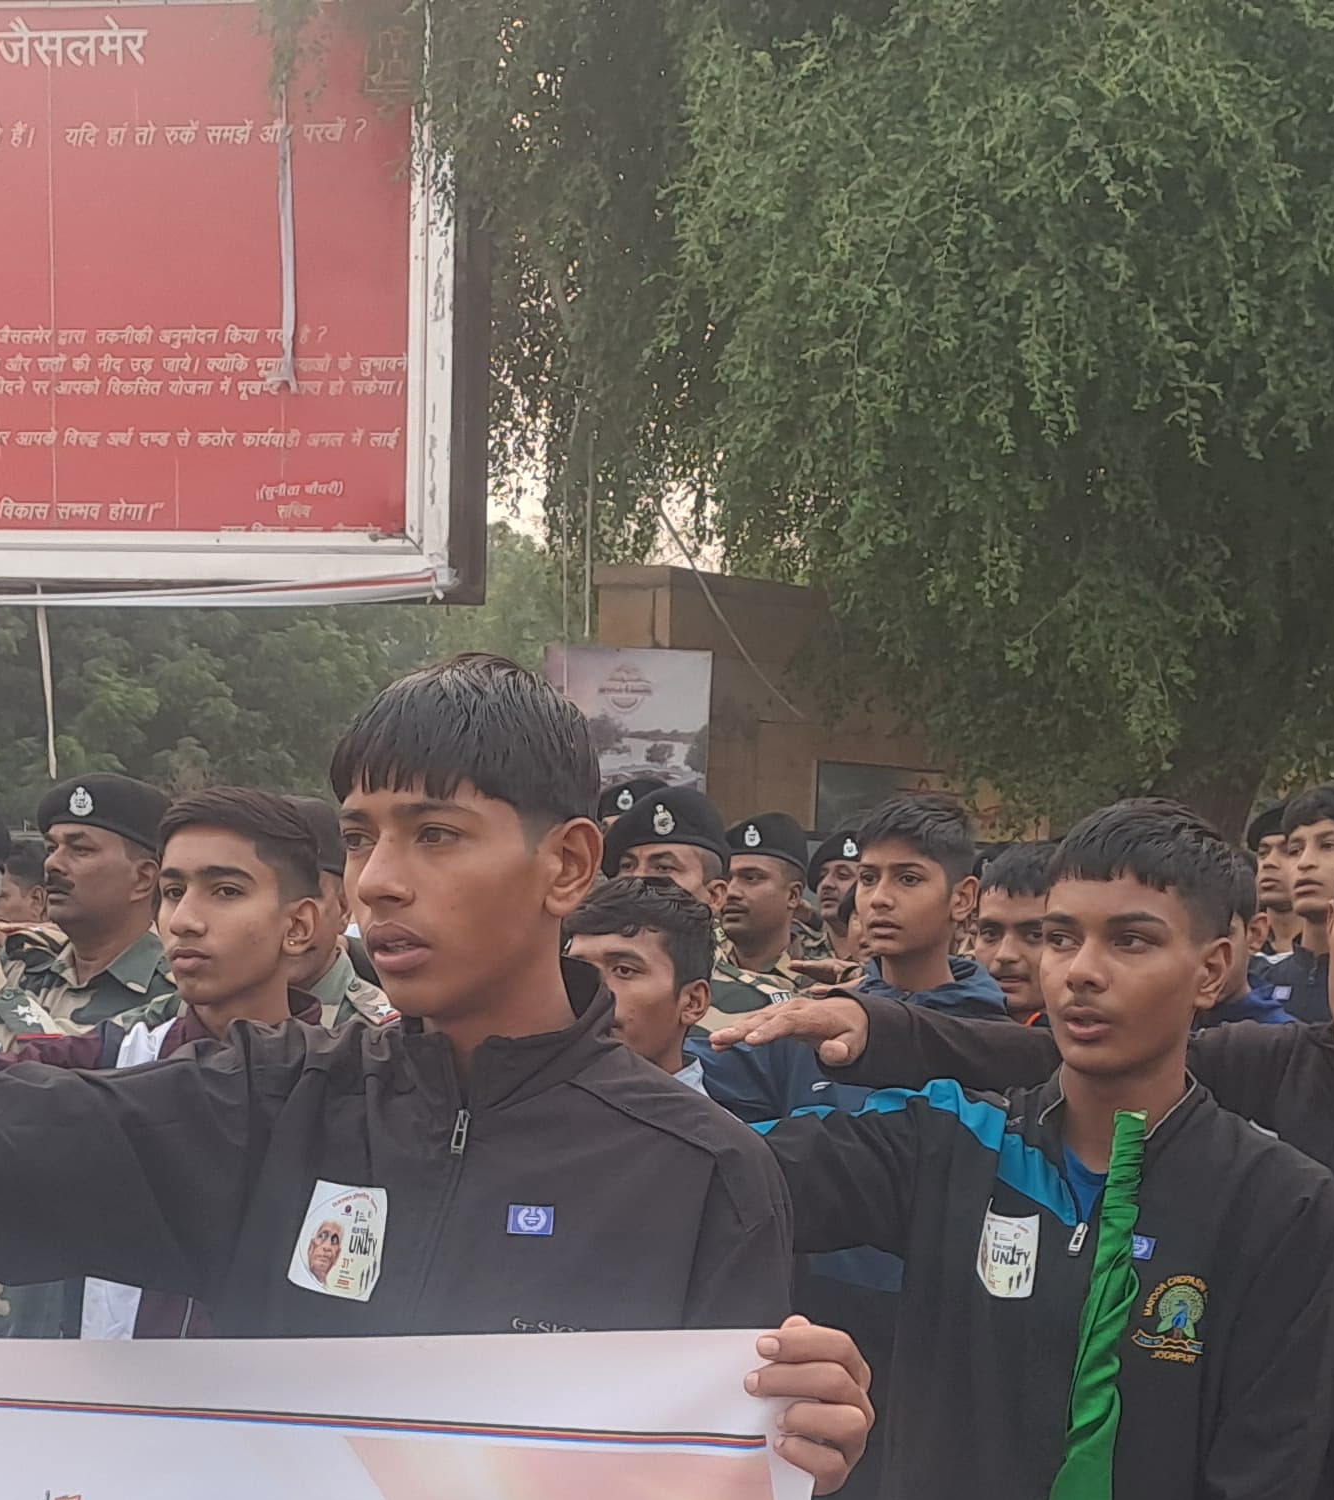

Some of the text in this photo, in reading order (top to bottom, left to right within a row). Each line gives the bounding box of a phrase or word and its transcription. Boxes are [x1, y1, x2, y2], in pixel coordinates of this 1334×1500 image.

[65, 121, 99, 146] यदि
[134, 119, 157, 145] तो
[207, 118, 253, 145] समझें
[96, 325, 154, 344] तकनीकी
[159, 325, 219, 349] अनुमोदन
[224, 325, 259, 344] किया
[72, 353, 91, 372] की
[32, 380, 50, 395] पर
[55, 376, 101, 396] आपको
[107, 376, 163, 396] विकसित
[169, 376, 214, 396] योजना
[220, 375, 231, 395] में
[16, 428, 57, 447] आपके
[177, 426, 190, 446] से
[197, 428, 236, 447] कठोर
[370, 426, 401, 449] लाई
[57, 502, 103, 521] सम्भव
